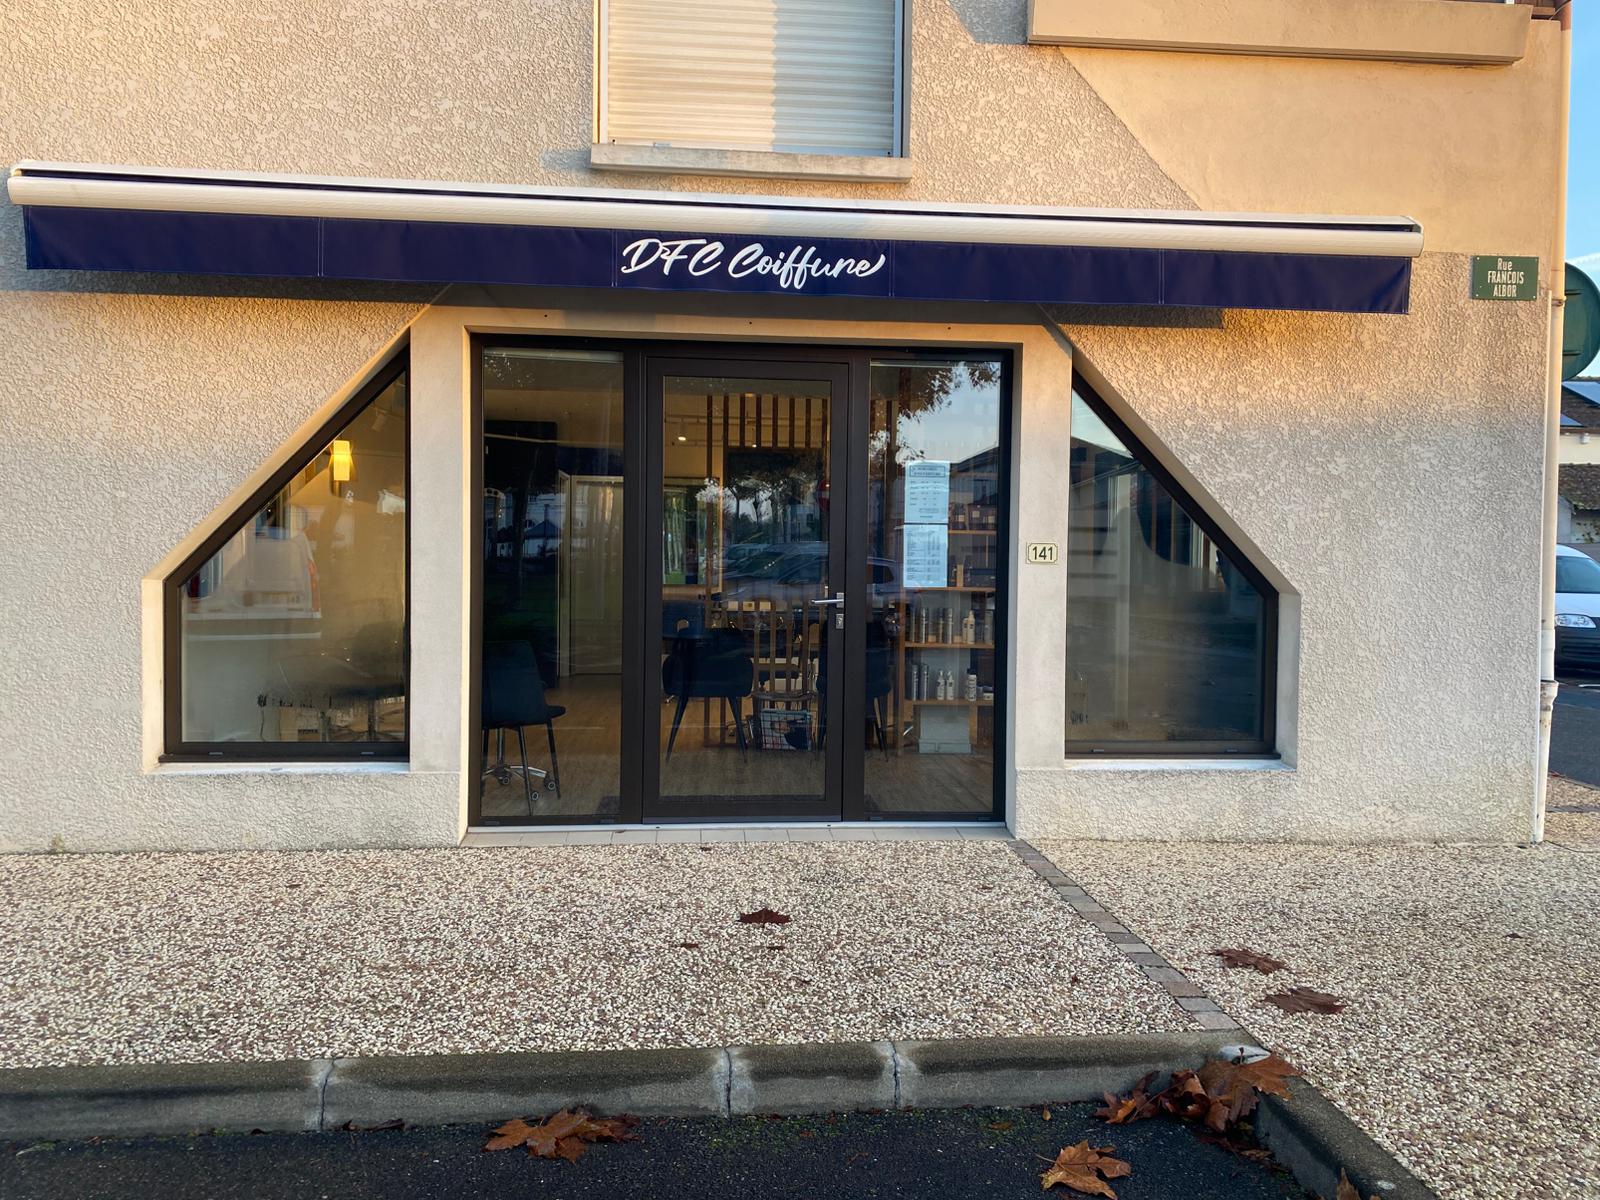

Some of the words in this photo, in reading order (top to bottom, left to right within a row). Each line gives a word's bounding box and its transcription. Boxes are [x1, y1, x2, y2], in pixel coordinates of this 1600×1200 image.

[621, 238, 725, 276] DFC
[727, 242, 886, 290] Coiffure
[1497, 257, 1513, 271] Rue
[1487, 270, 1525, 284] FRANCOIS
[1492, 284, 1517, 298] ALBOR
[1032, 546, 1054, 561] 141
